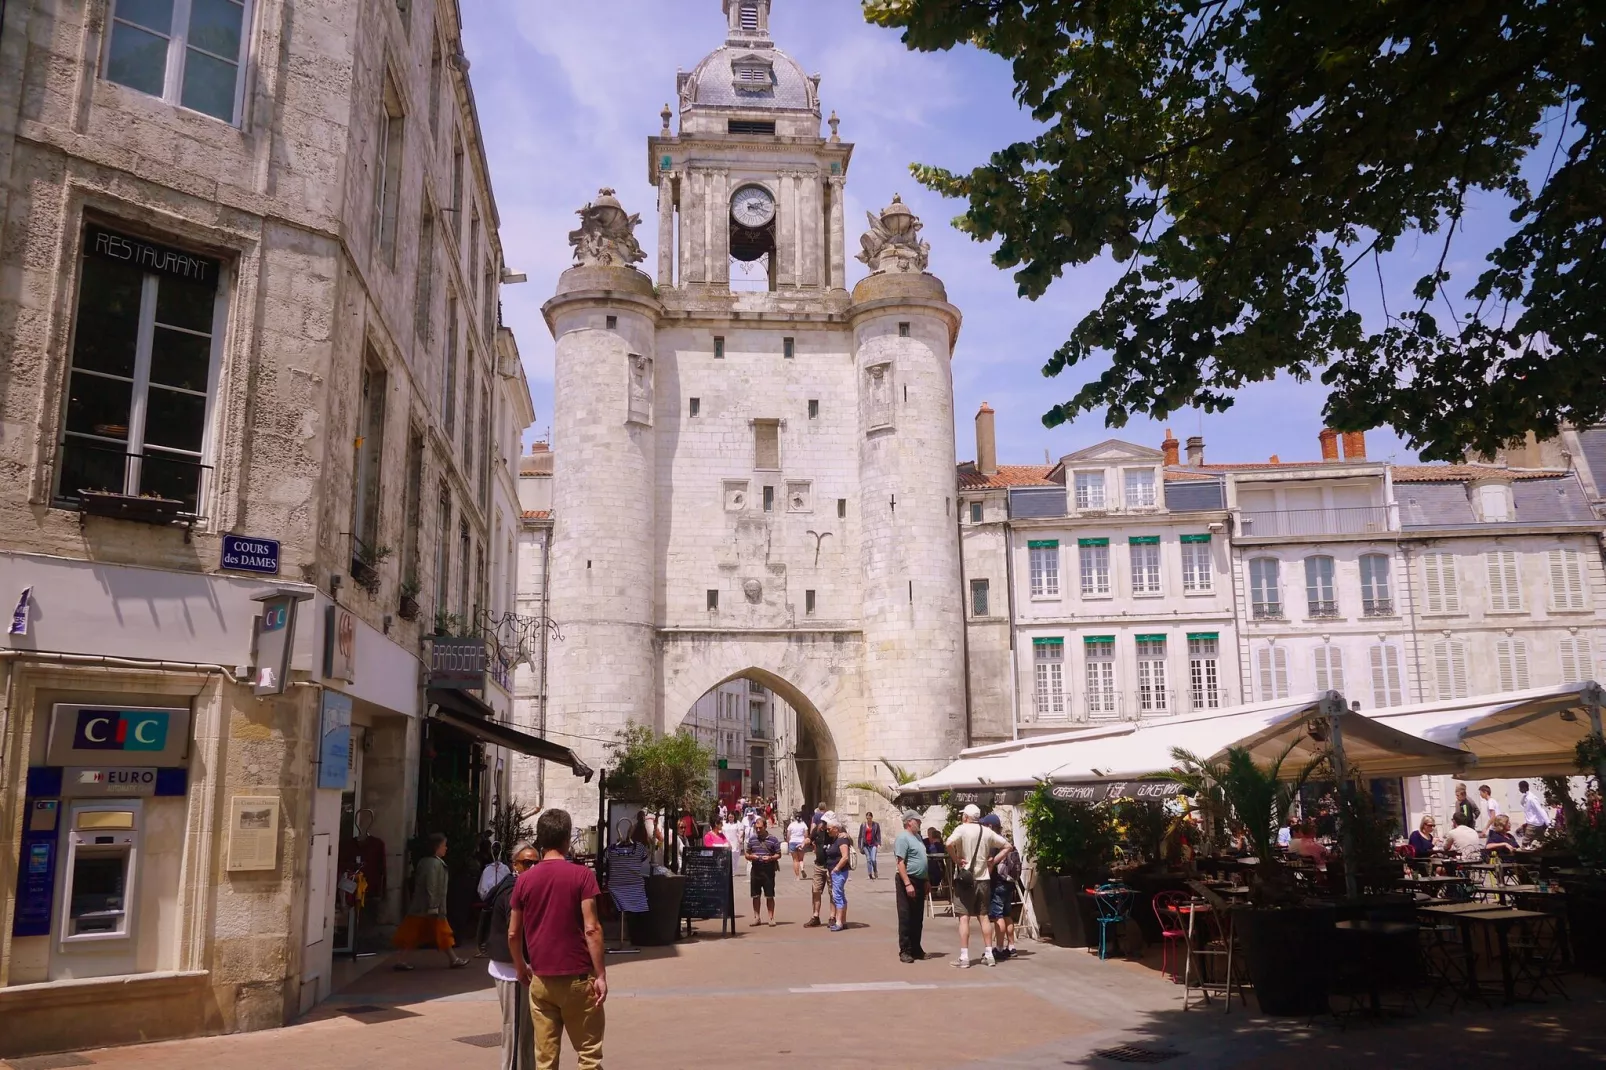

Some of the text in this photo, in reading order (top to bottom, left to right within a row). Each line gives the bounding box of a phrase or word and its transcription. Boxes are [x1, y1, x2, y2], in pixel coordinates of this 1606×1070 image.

[95, 232, 209, 280] RESTAURANT
[233, 541, 270, 555] COURS
[224, 552, 277, 569] des DAMES
[266, 608, 284, 626] CIC
[432, 644, 485, 672] BRASSERIE
[84, 718, 159, 743] CIC
[107, 771, 154, 783] EURO
